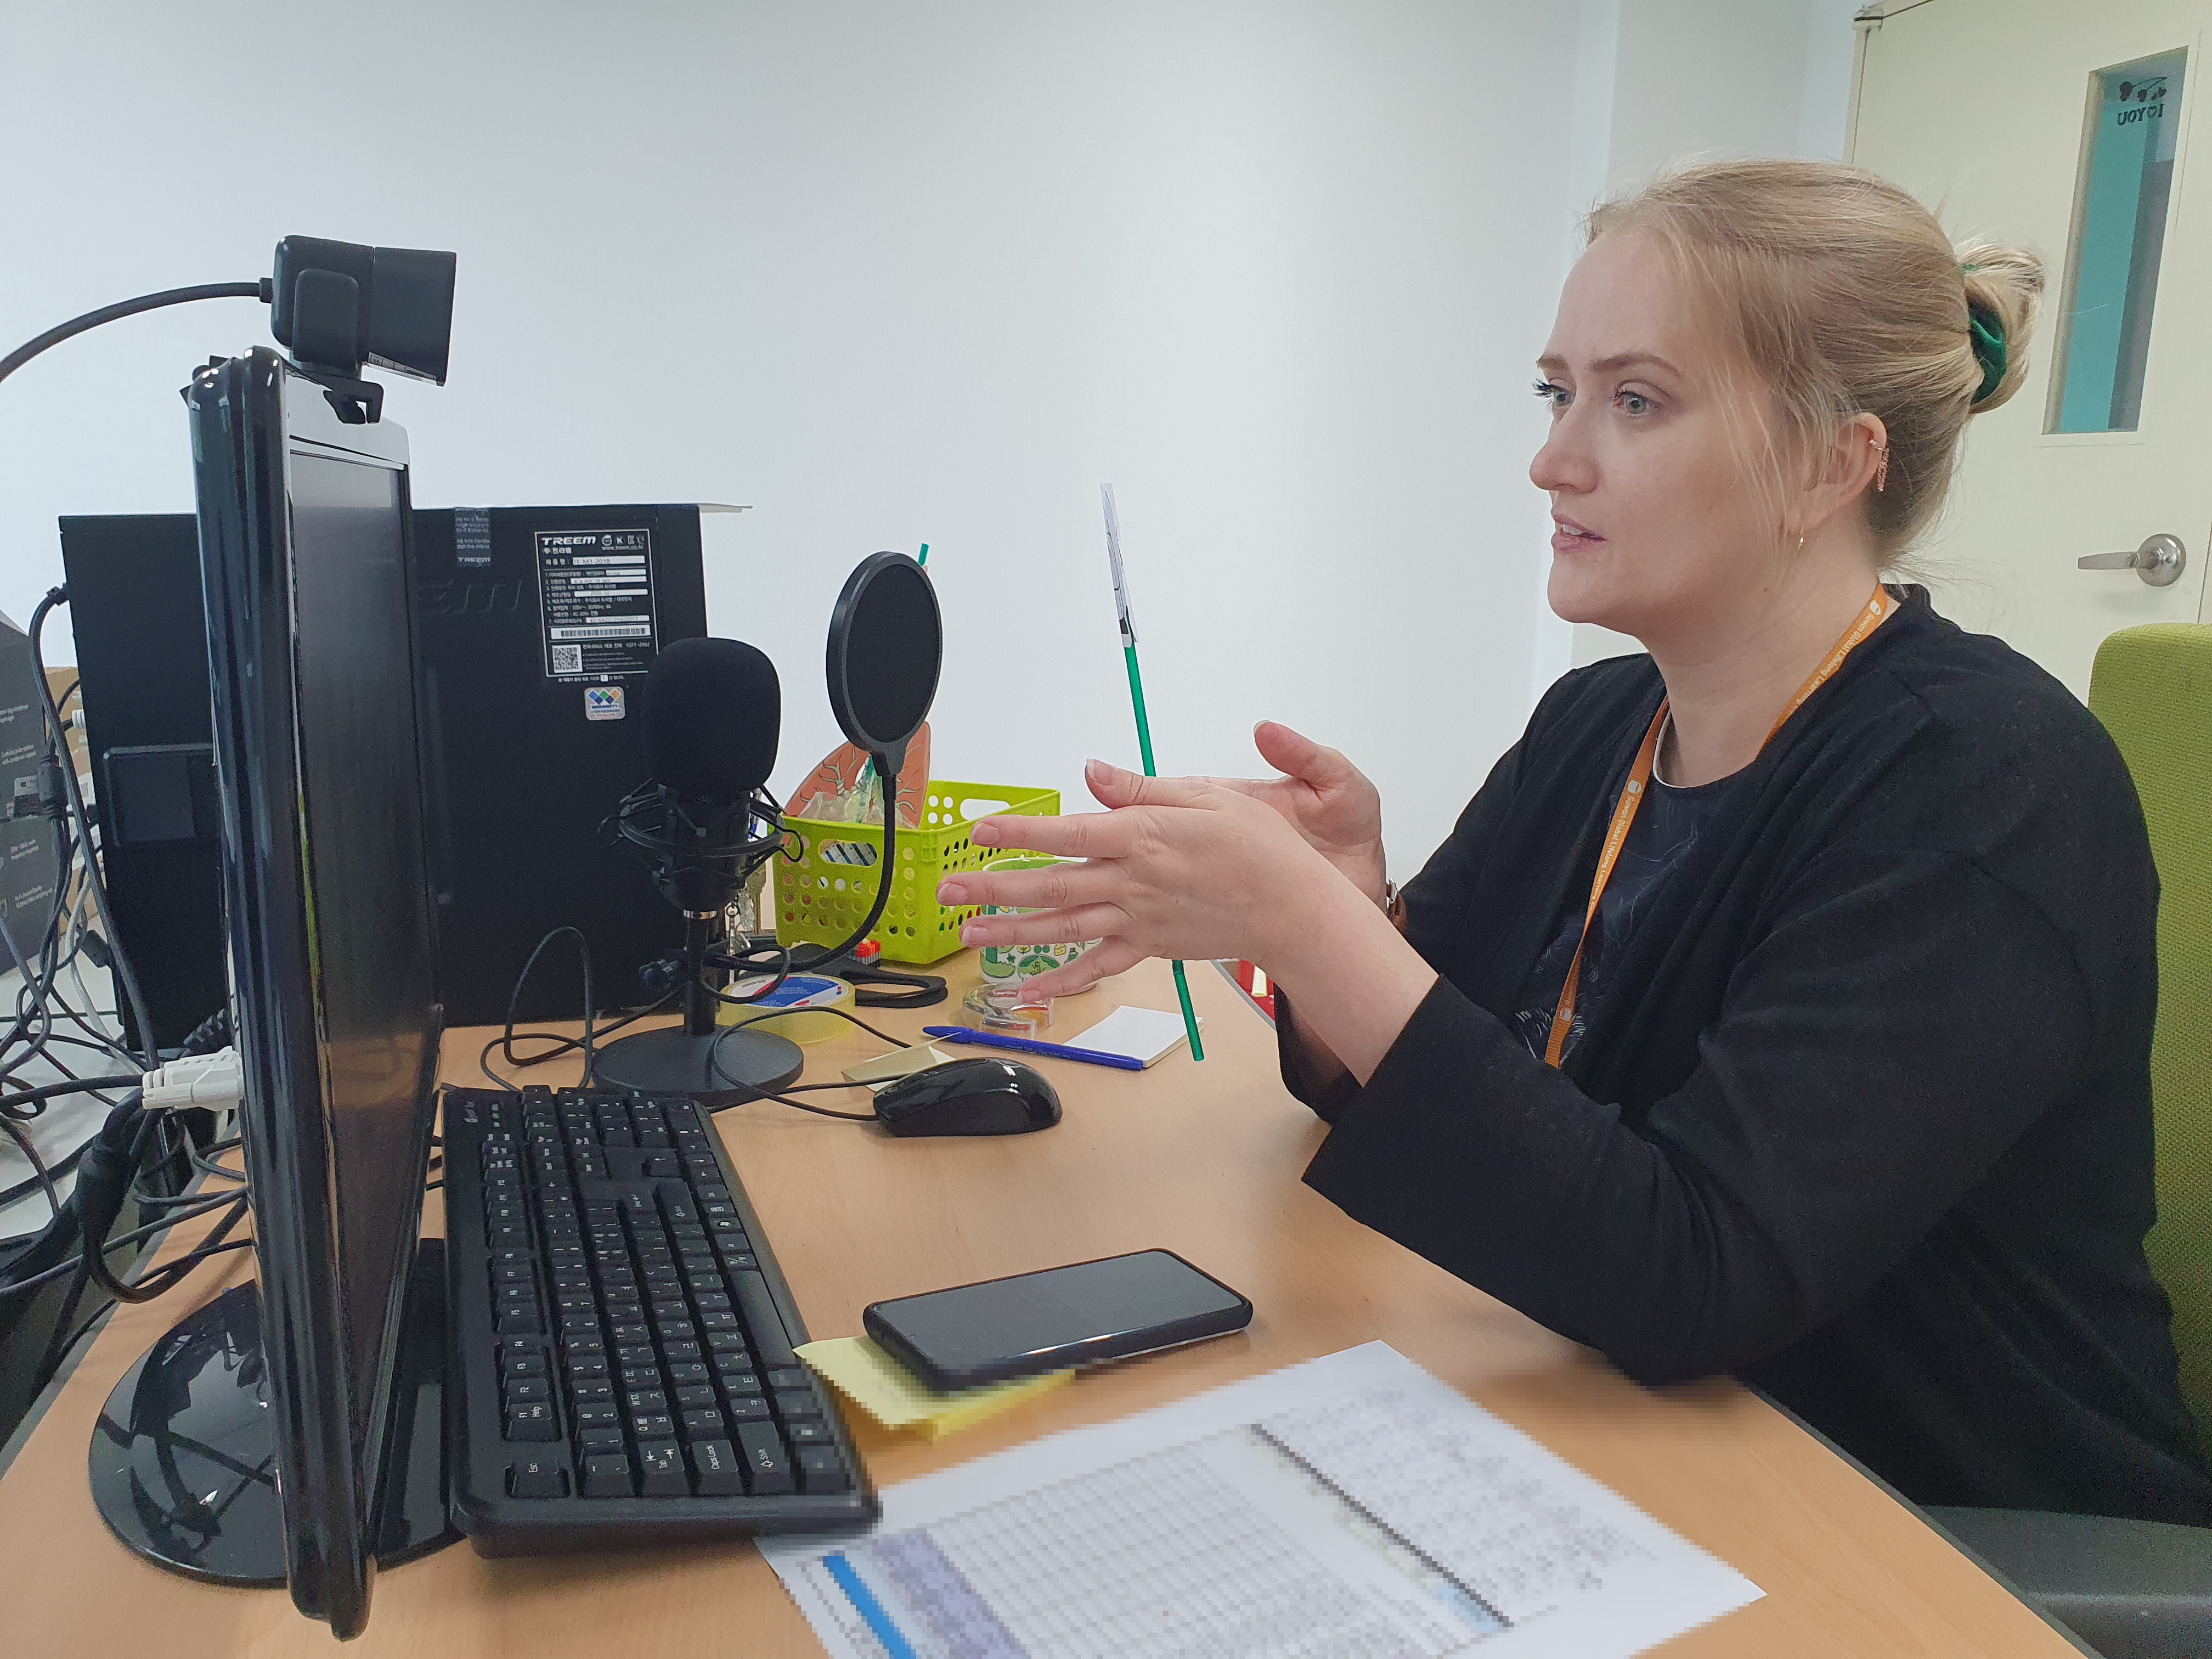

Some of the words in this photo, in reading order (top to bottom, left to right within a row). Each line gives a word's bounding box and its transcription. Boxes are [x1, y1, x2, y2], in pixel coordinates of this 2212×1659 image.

[541, 536, 597, 546] TREEM
[1842, 631, 1861, 653] Global
[1820, 650, 1844, 676] Lifelong
[1612, 819, 1626, 842] Global
[1601, 840, 1617, 869] Lifelong
[1592, 870, 1606, 900] Learning
[531, 1406, 542, 1417] Help
[706, 1444, 716, 1457] Lock
[528, 1463, 538, 1472] Esc
[658, 1460, 668, 1469] Tab
[710, 1457, 720, 1469] Caps
